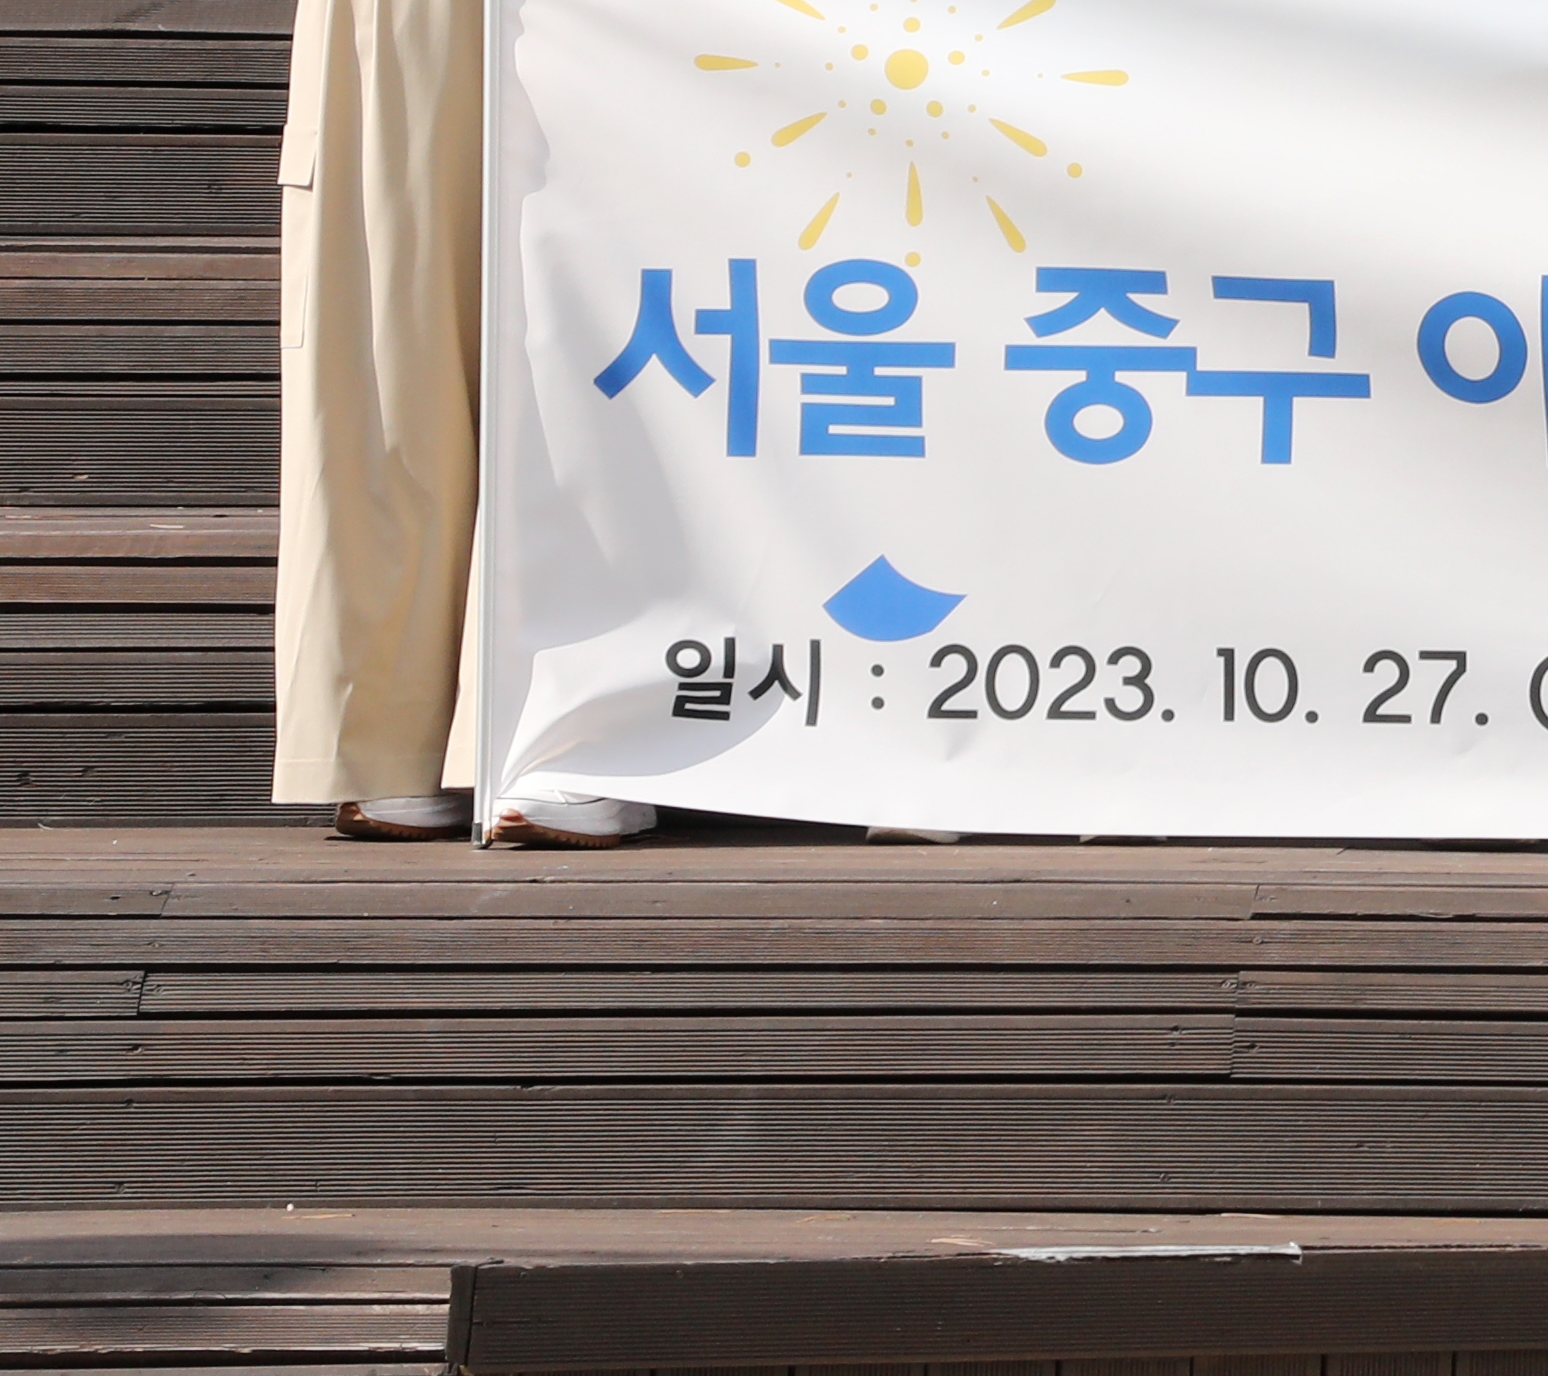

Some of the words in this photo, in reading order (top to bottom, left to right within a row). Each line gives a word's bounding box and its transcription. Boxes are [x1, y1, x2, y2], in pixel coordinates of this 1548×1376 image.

[596, 259, 954, 456] 서울
[1006, 268, 1370, 463] 중구
[667, 638, 820, 725] 일시
[872, 665, 883, 708] :
[928, 645, 1174, 721] 2023.
[1218, 649, 1318, 723] 10.
[1363, 651, 1488, 725] 27.
